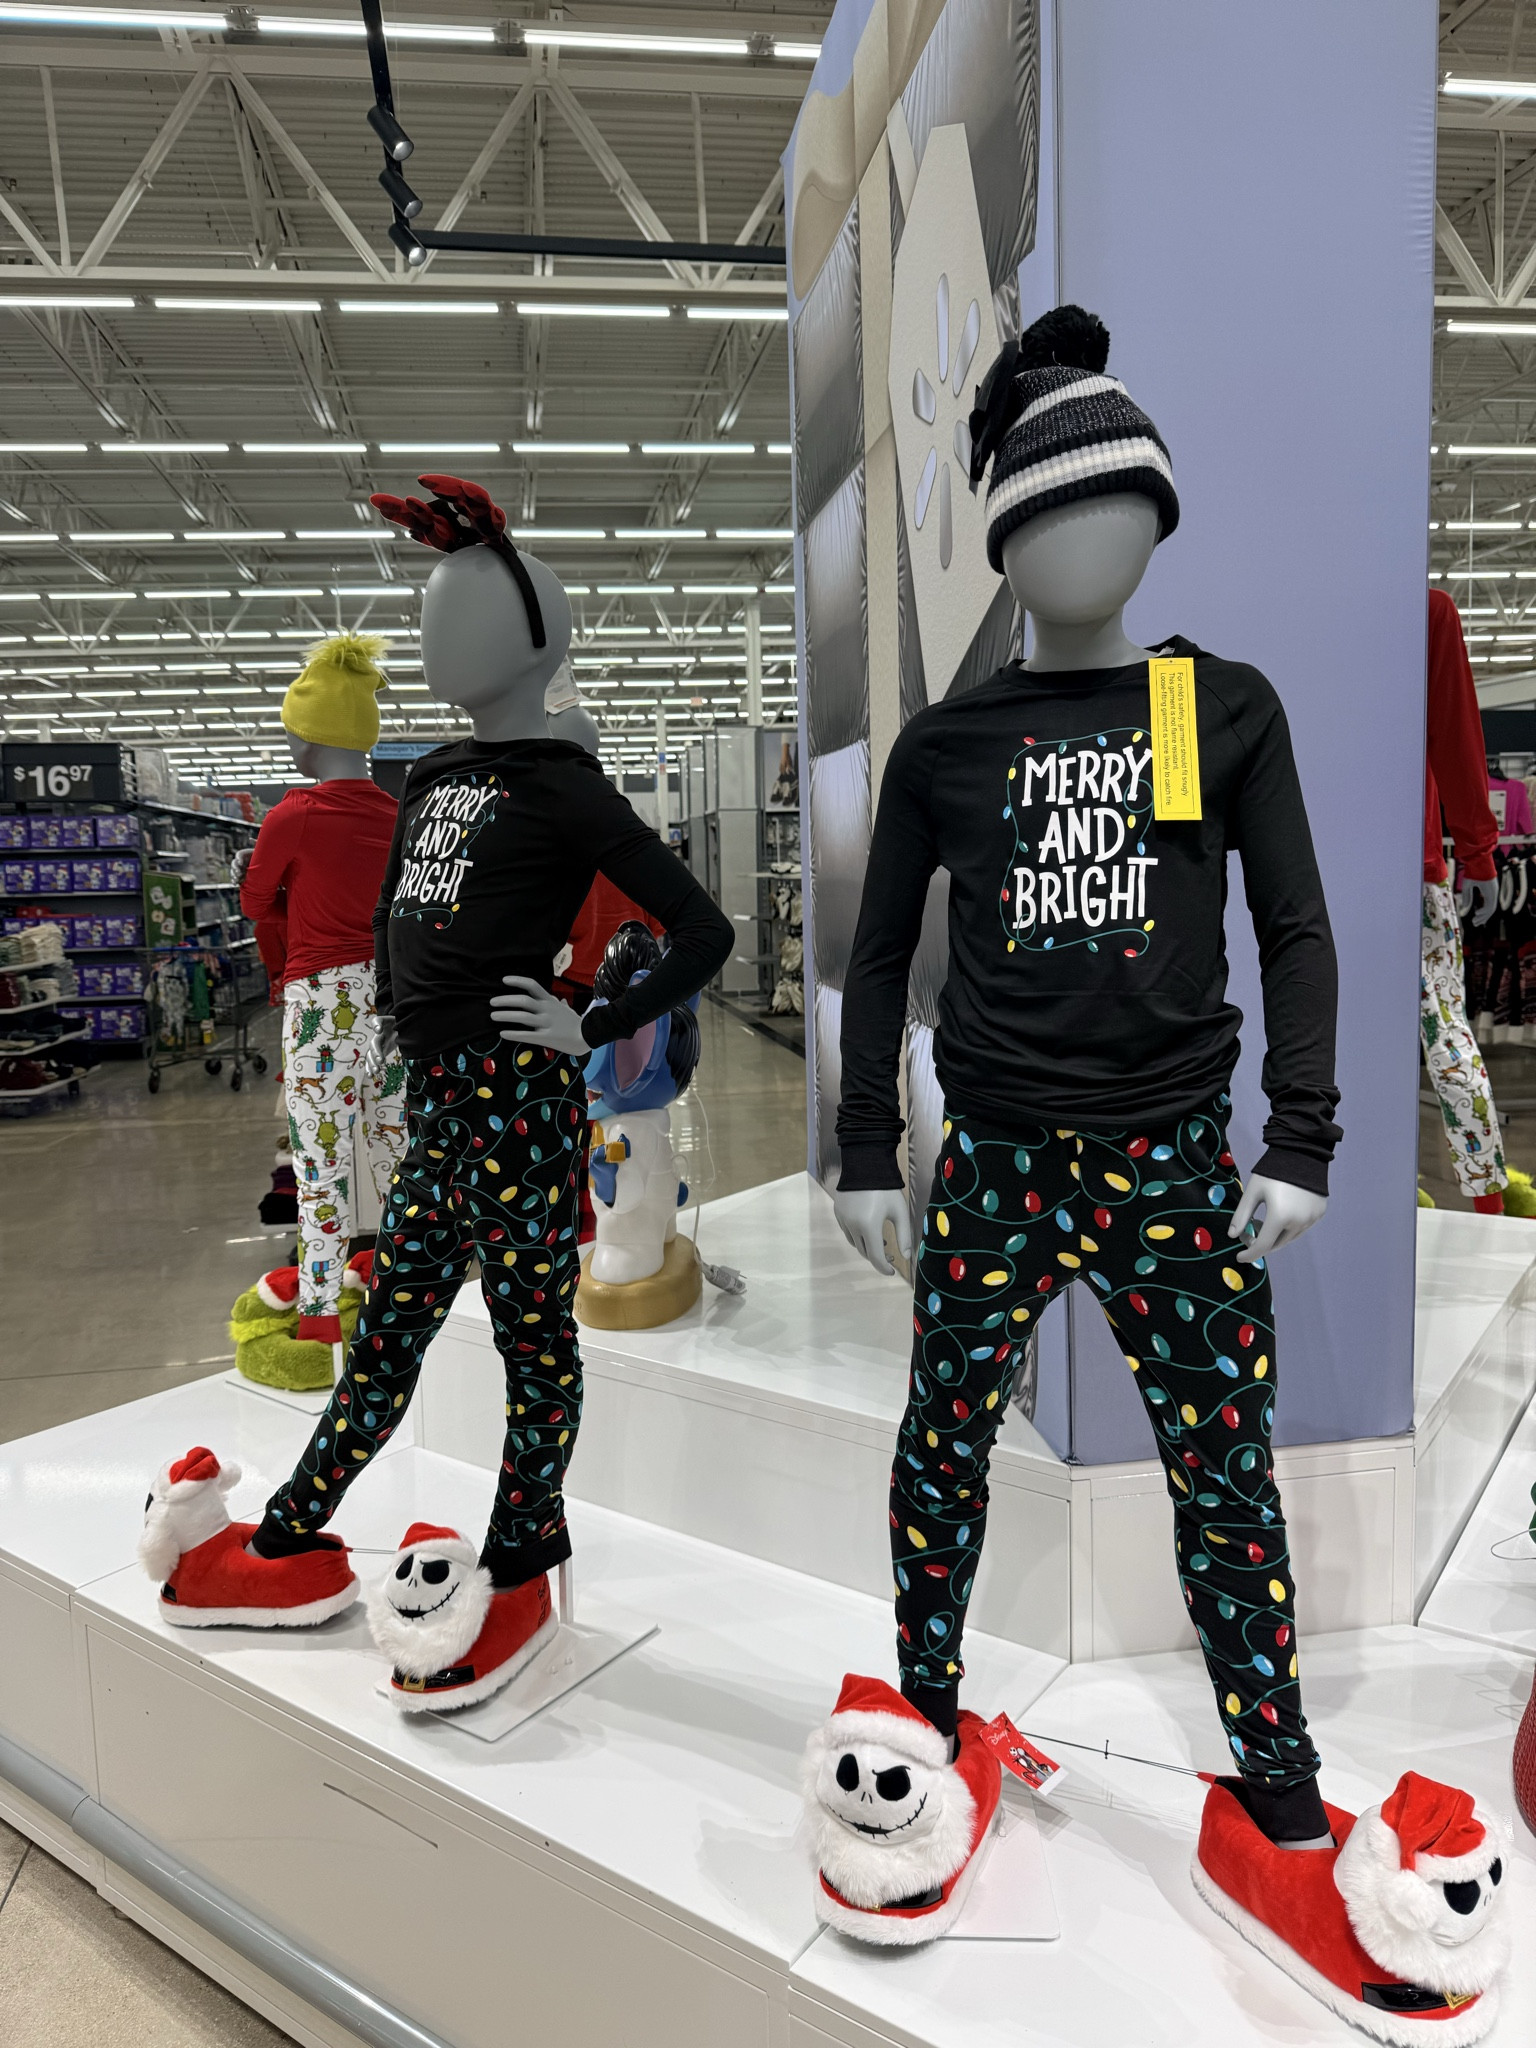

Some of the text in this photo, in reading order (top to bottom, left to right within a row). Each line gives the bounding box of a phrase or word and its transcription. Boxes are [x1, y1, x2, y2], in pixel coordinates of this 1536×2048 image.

[1178, 724, 1186, 747] garment
[1021, 745, 1153, 807] MERRY
[419, 784, 499, 823] MERRY
[413, 819, 461, 861] AND
[1038, 807, 1126, 865] AND
[393, 857, 474, 904] BRIGHT
[1012, 857, 1159, 930] BRIGHT
[986, 1729, 1010, 1746] Disney
